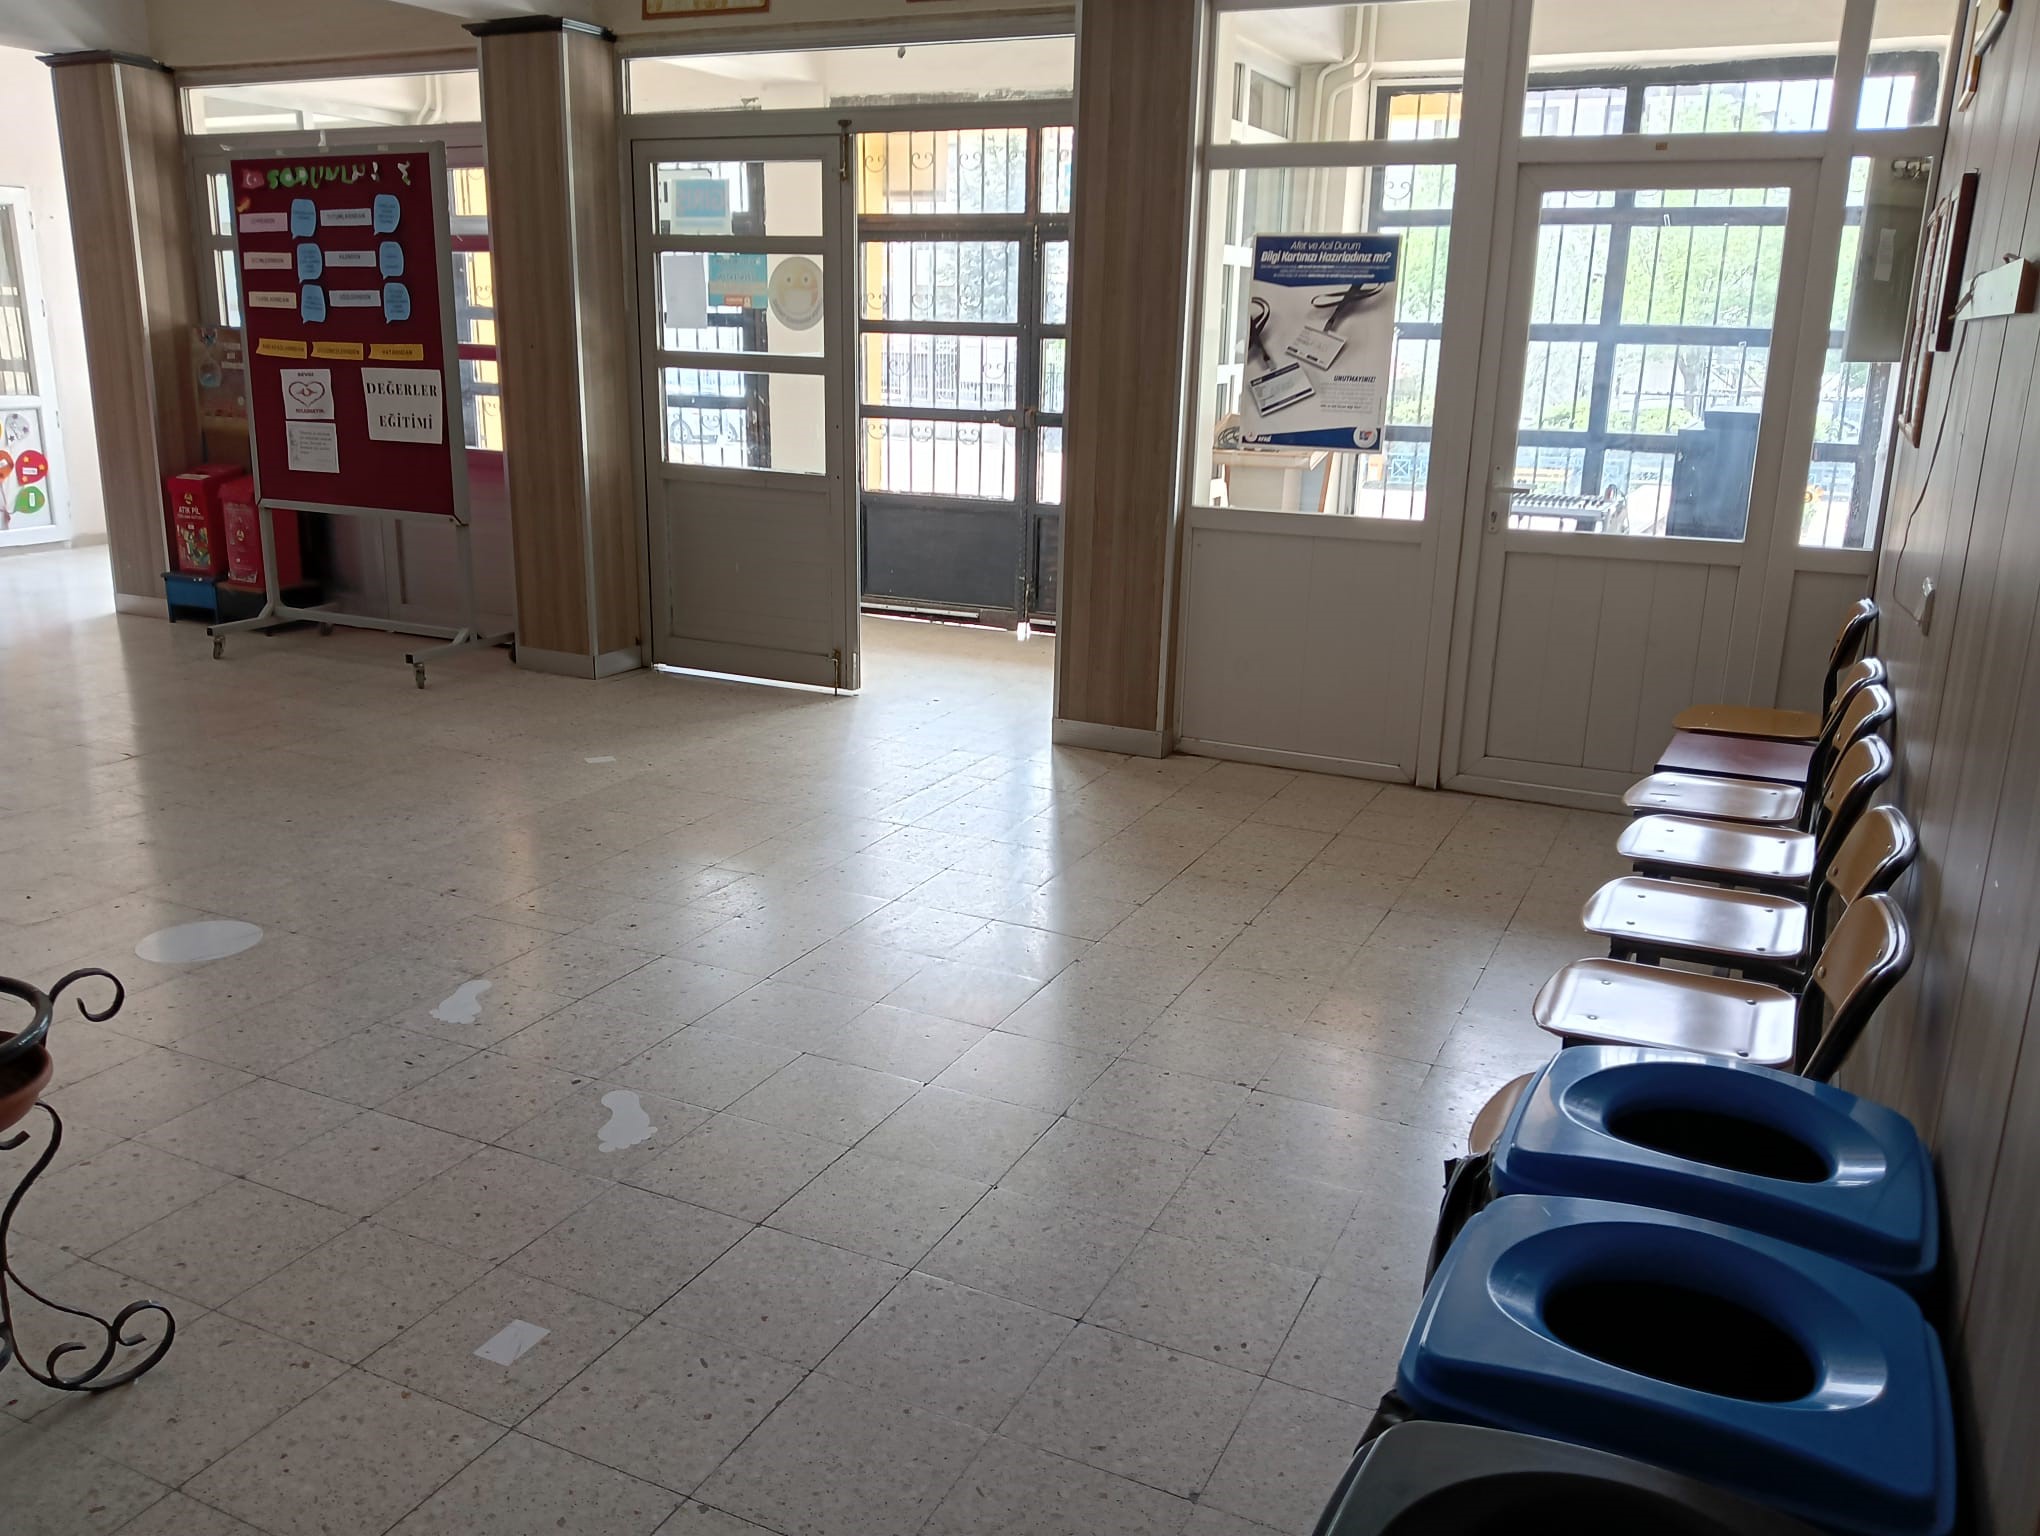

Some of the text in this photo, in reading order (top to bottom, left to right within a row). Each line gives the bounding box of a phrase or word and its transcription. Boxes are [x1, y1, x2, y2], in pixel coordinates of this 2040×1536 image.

[1318, 240, 1334, 250] Acil
[1333, 240, 1362, 251] Durum
[1261, 250, 1282, 265] Bilgi
[1318, 251, 1372, 263] Hazırladınız
[366, 380, 437, 397] DEĞERLER
[379, 412, 432, 430] EĞİTİMİ
